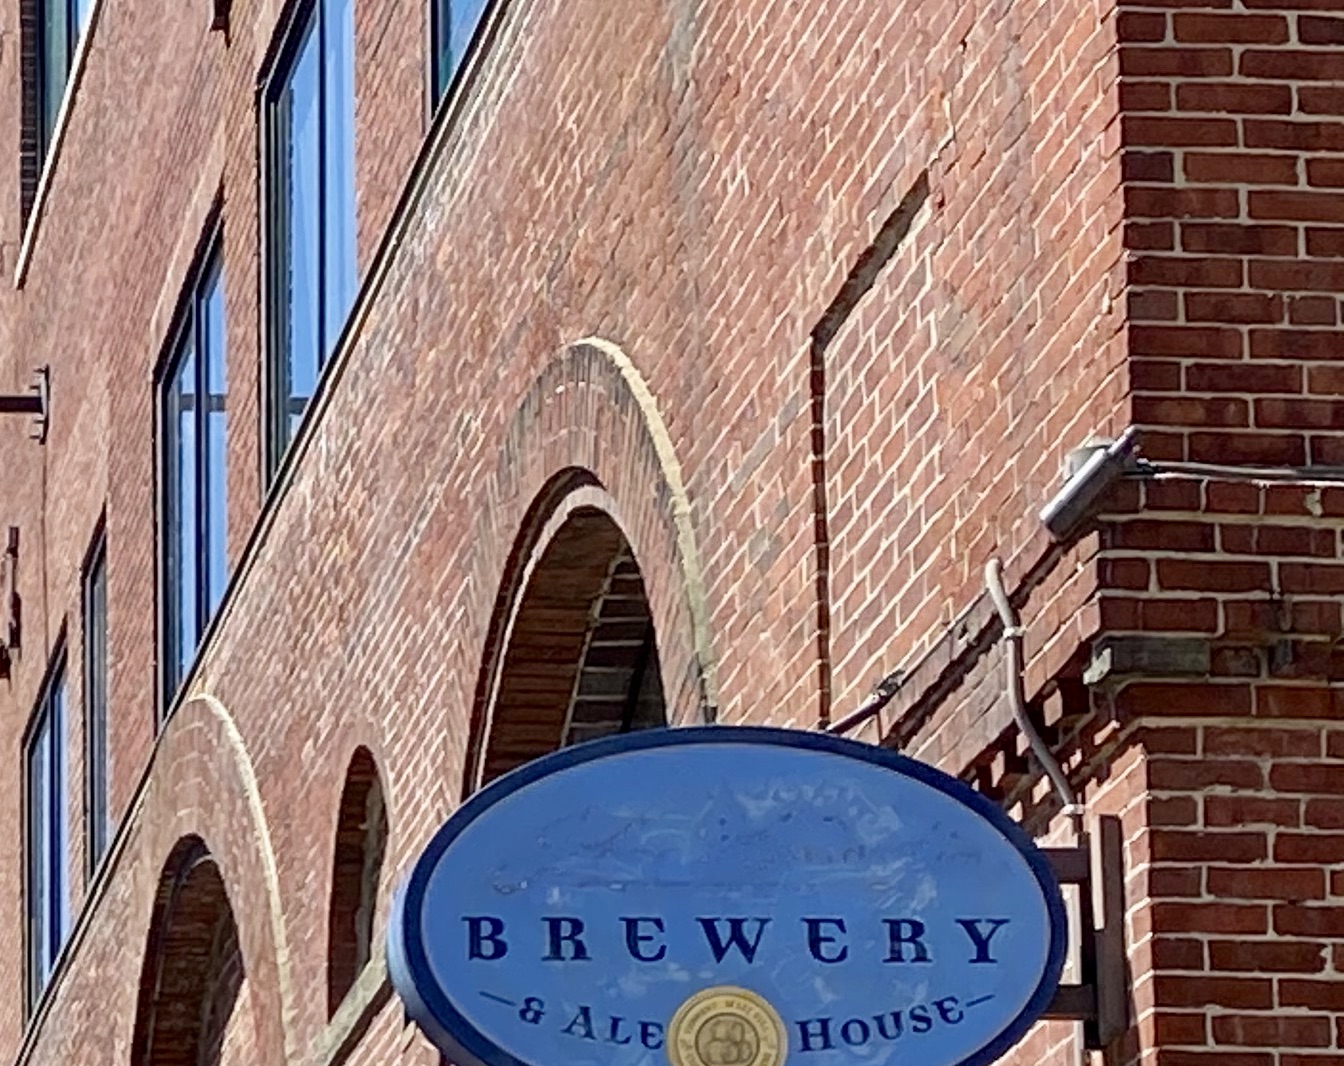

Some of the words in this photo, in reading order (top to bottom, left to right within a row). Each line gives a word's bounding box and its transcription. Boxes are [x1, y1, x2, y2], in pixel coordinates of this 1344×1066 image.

[461, 916, 1010, 964] BREWERY
[518, 997, 546, 1025] &
[795, 996, 965, 1053] HOUSE
